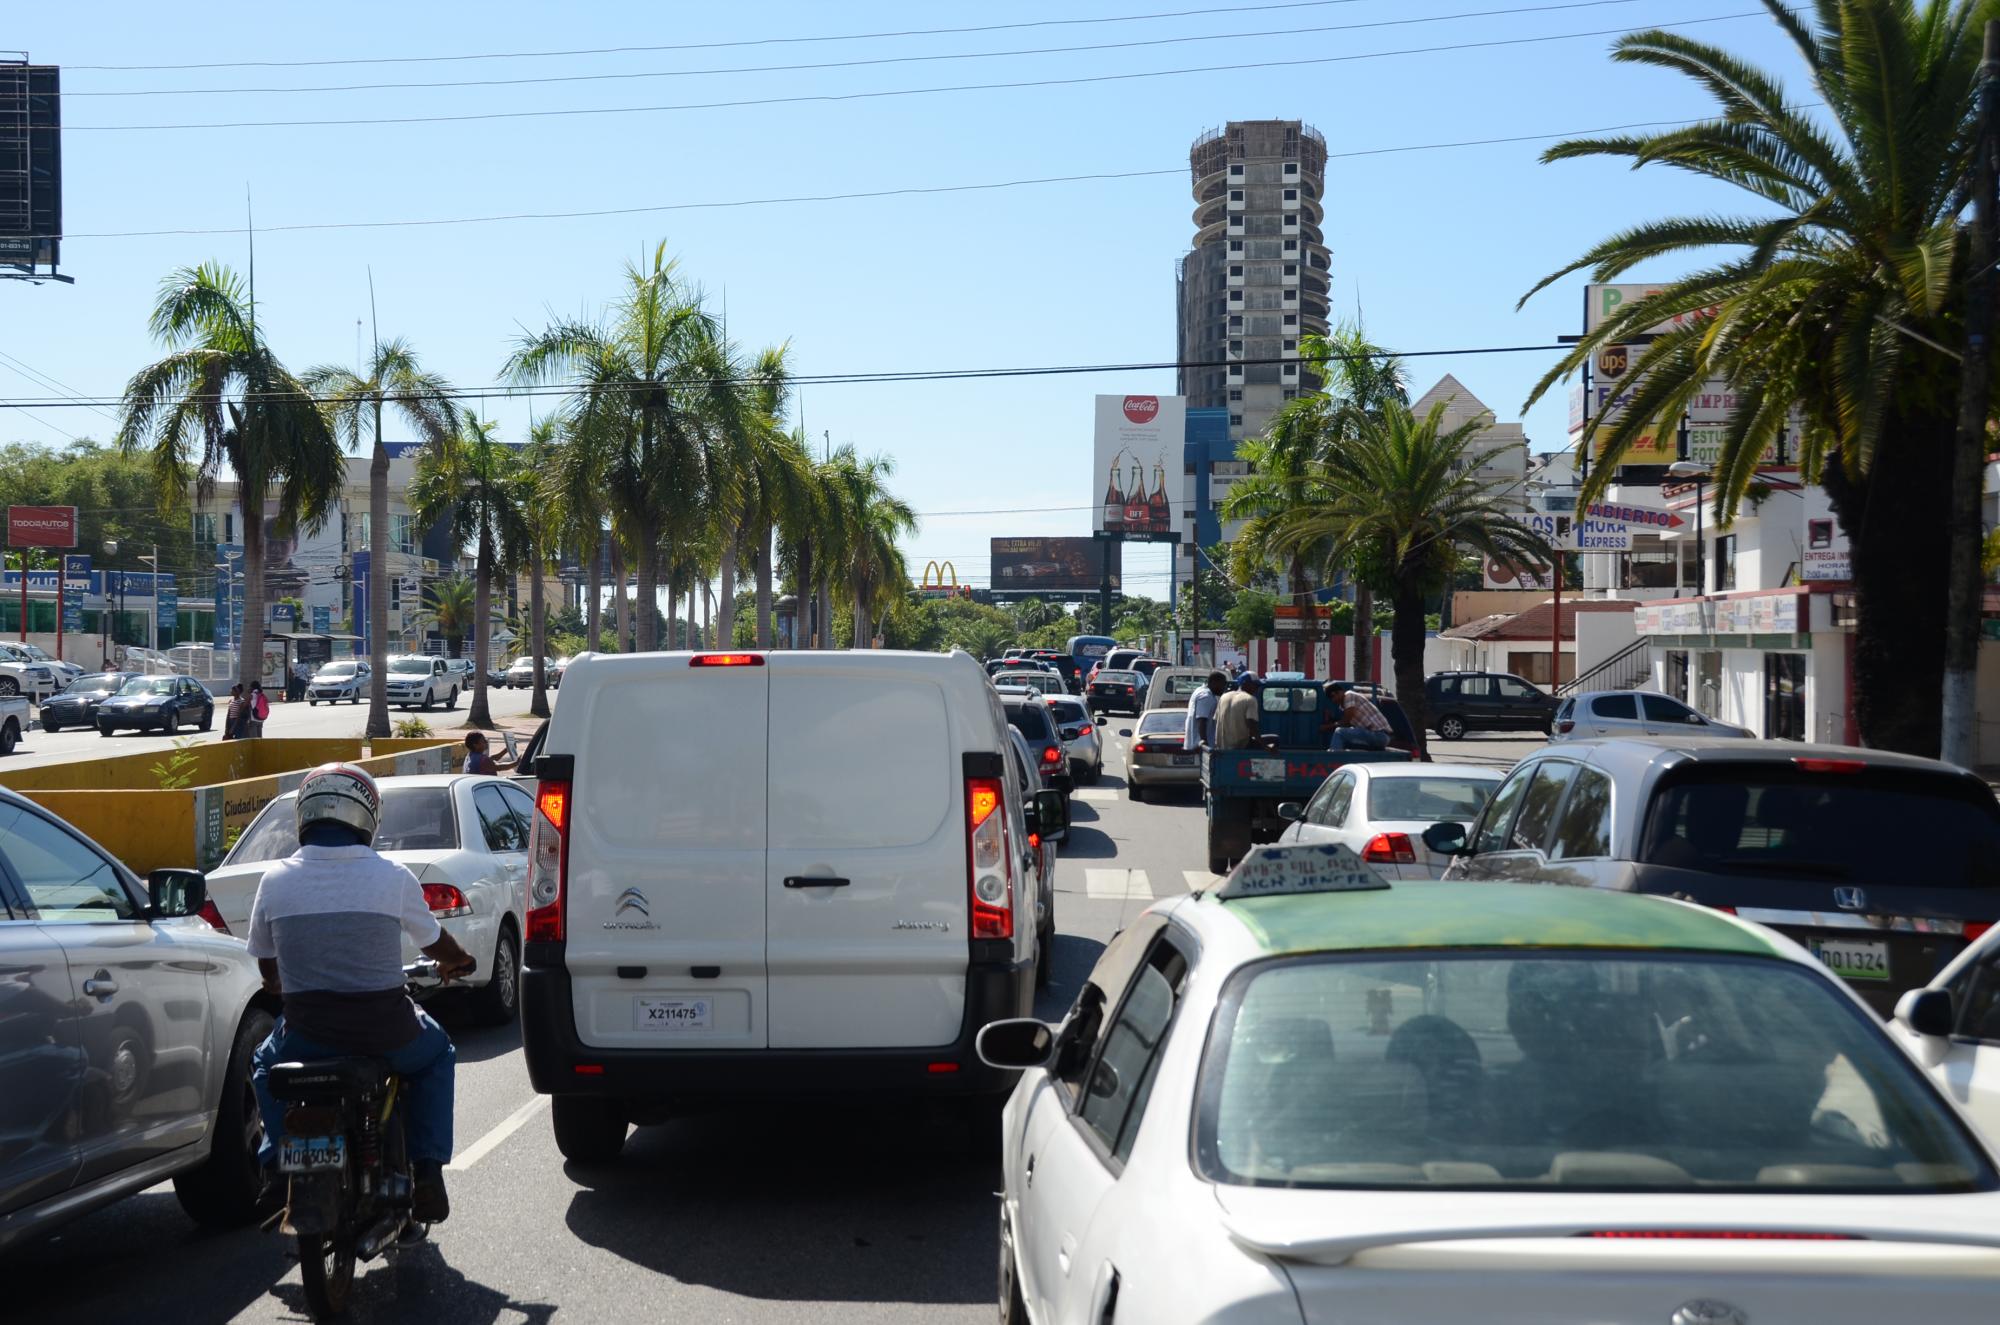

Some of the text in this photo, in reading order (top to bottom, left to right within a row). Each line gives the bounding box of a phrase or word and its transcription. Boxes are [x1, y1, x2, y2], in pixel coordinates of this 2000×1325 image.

[1599, 353, 1627, 374] ups
[1589, 503, 1669, 527] ABIERTO
[1584, 536, 1627, 548] EXPRESS
[1804, 552, 1836, 561] ENTREGA
[224, 797, 251, 817] Ciudad
[648, 1008, 697, 1020] X211475
